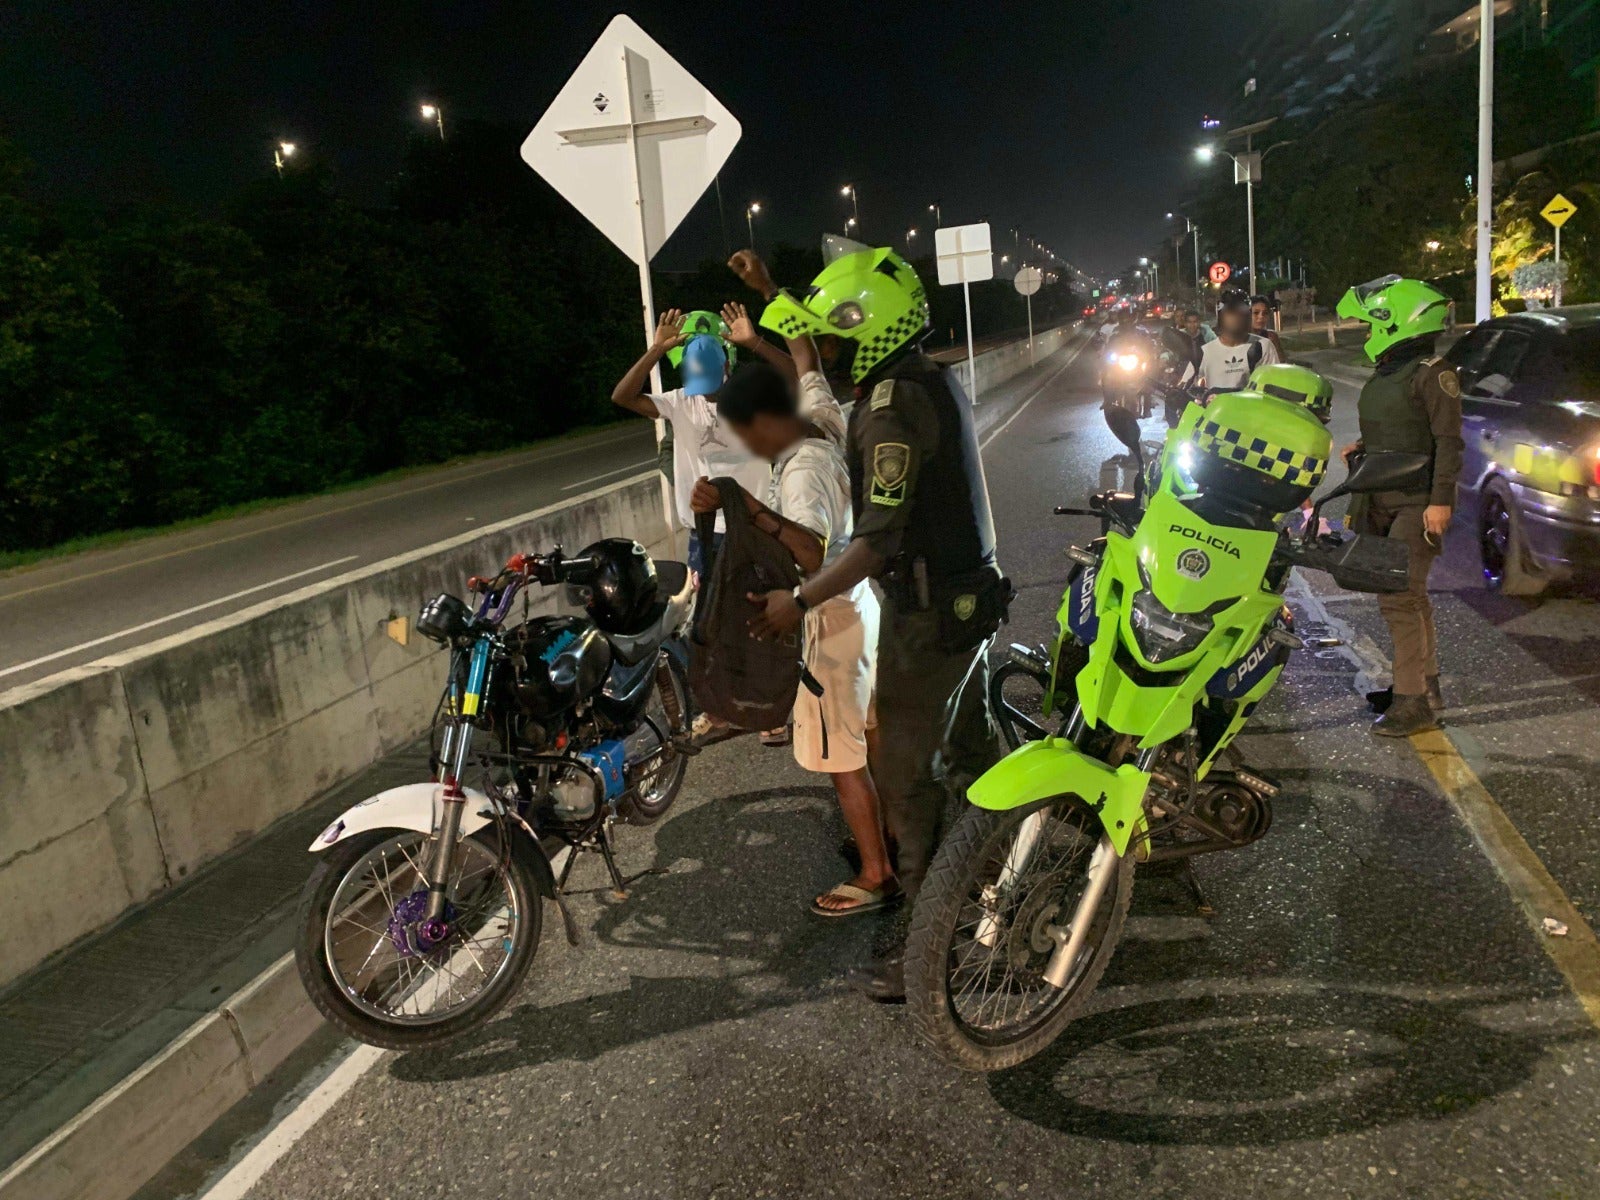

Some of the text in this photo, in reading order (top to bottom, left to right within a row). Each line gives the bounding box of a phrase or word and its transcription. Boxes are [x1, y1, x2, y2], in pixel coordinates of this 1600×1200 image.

[1215, 266, 1225, 279] P
[1169, 524, 1241, 560] POLICÍA
[1080, 565, 1095, 613] LICÍA
[1237, 619, 1287, 682] POLICA
